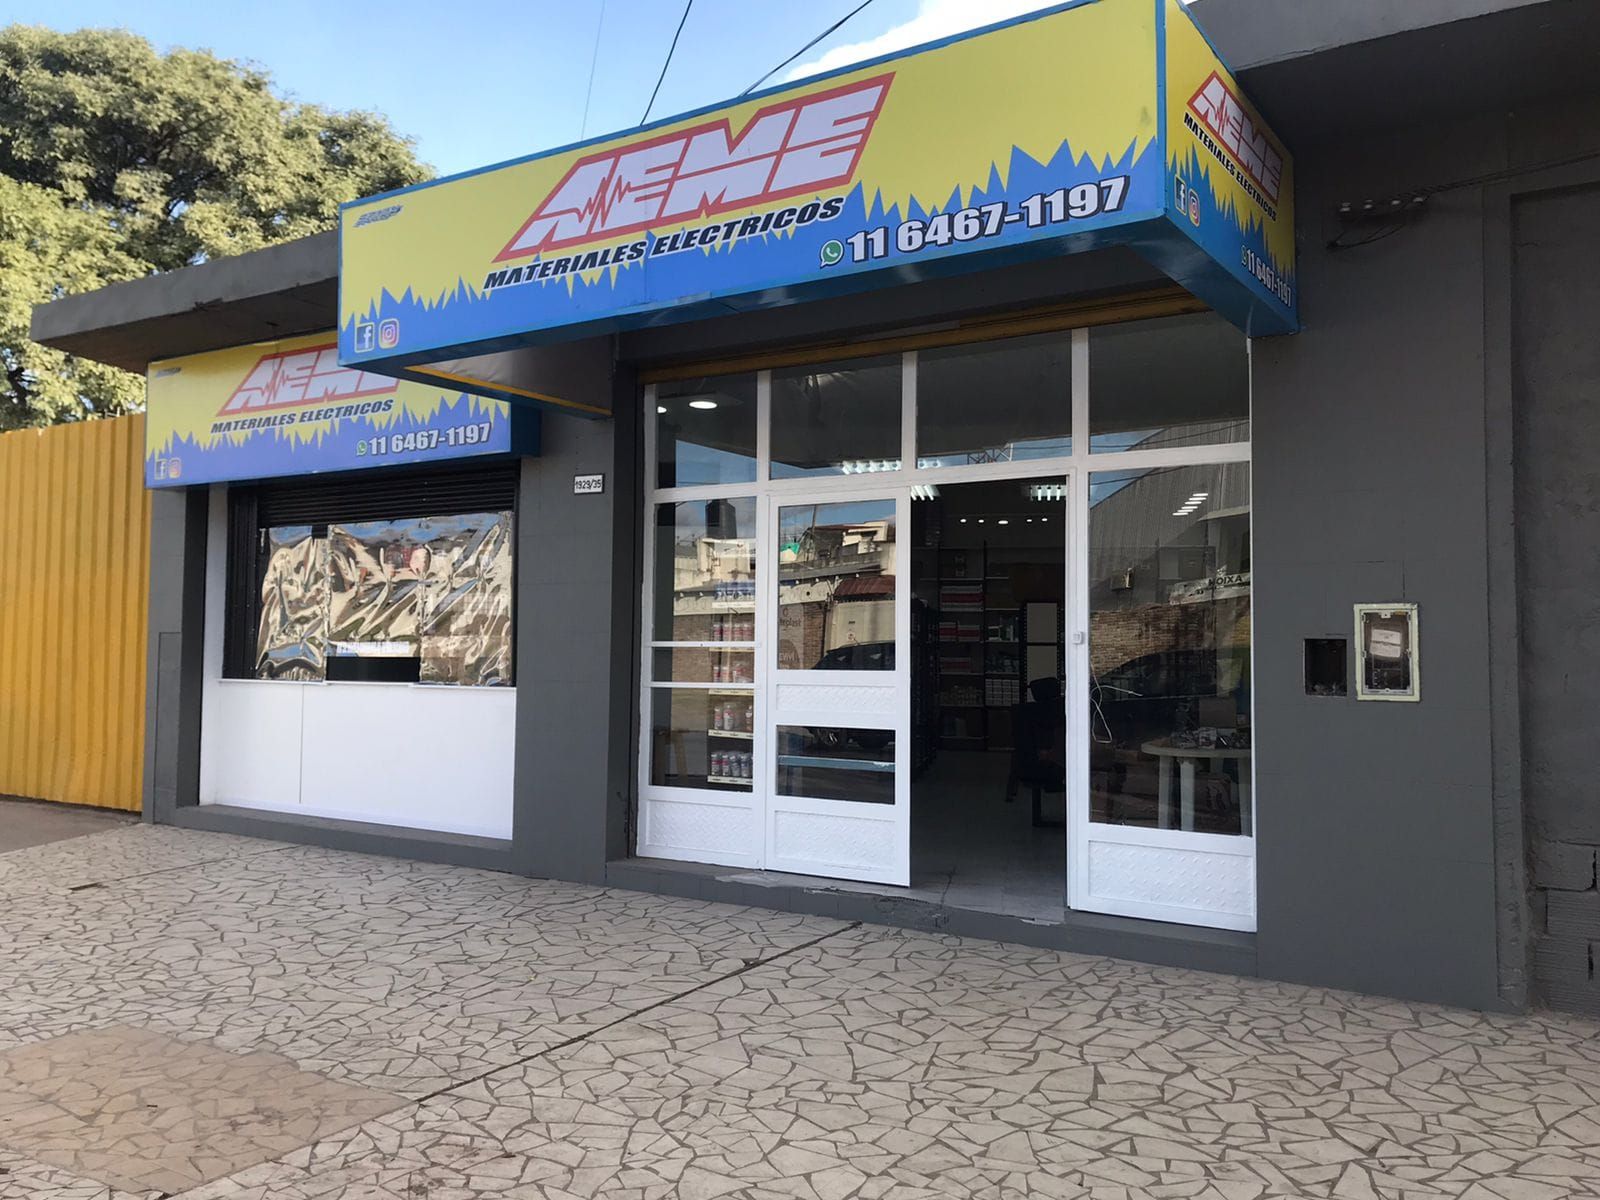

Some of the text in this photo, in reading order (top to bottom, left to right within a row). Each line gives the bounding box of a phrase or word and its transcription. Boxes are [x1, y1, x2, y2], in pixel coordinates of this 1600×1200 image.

[507, 83, 884, 253] AEME
[1184, 112, 1277, 221] MATERIALES ELECTRICOS
[1192, 74, 1283, 202] AEME
[484, 197, 844, 290] MATERIALES ELECTRICOS
[847, 175, 1130, 262] 11 6467-1197
[1247, 249, 1291, 307] 11 6467-1197
[210, 399, 394, 434] MATERIALES ELECTRICOS
[369, 422, 492, 455] 11 6467-1197
